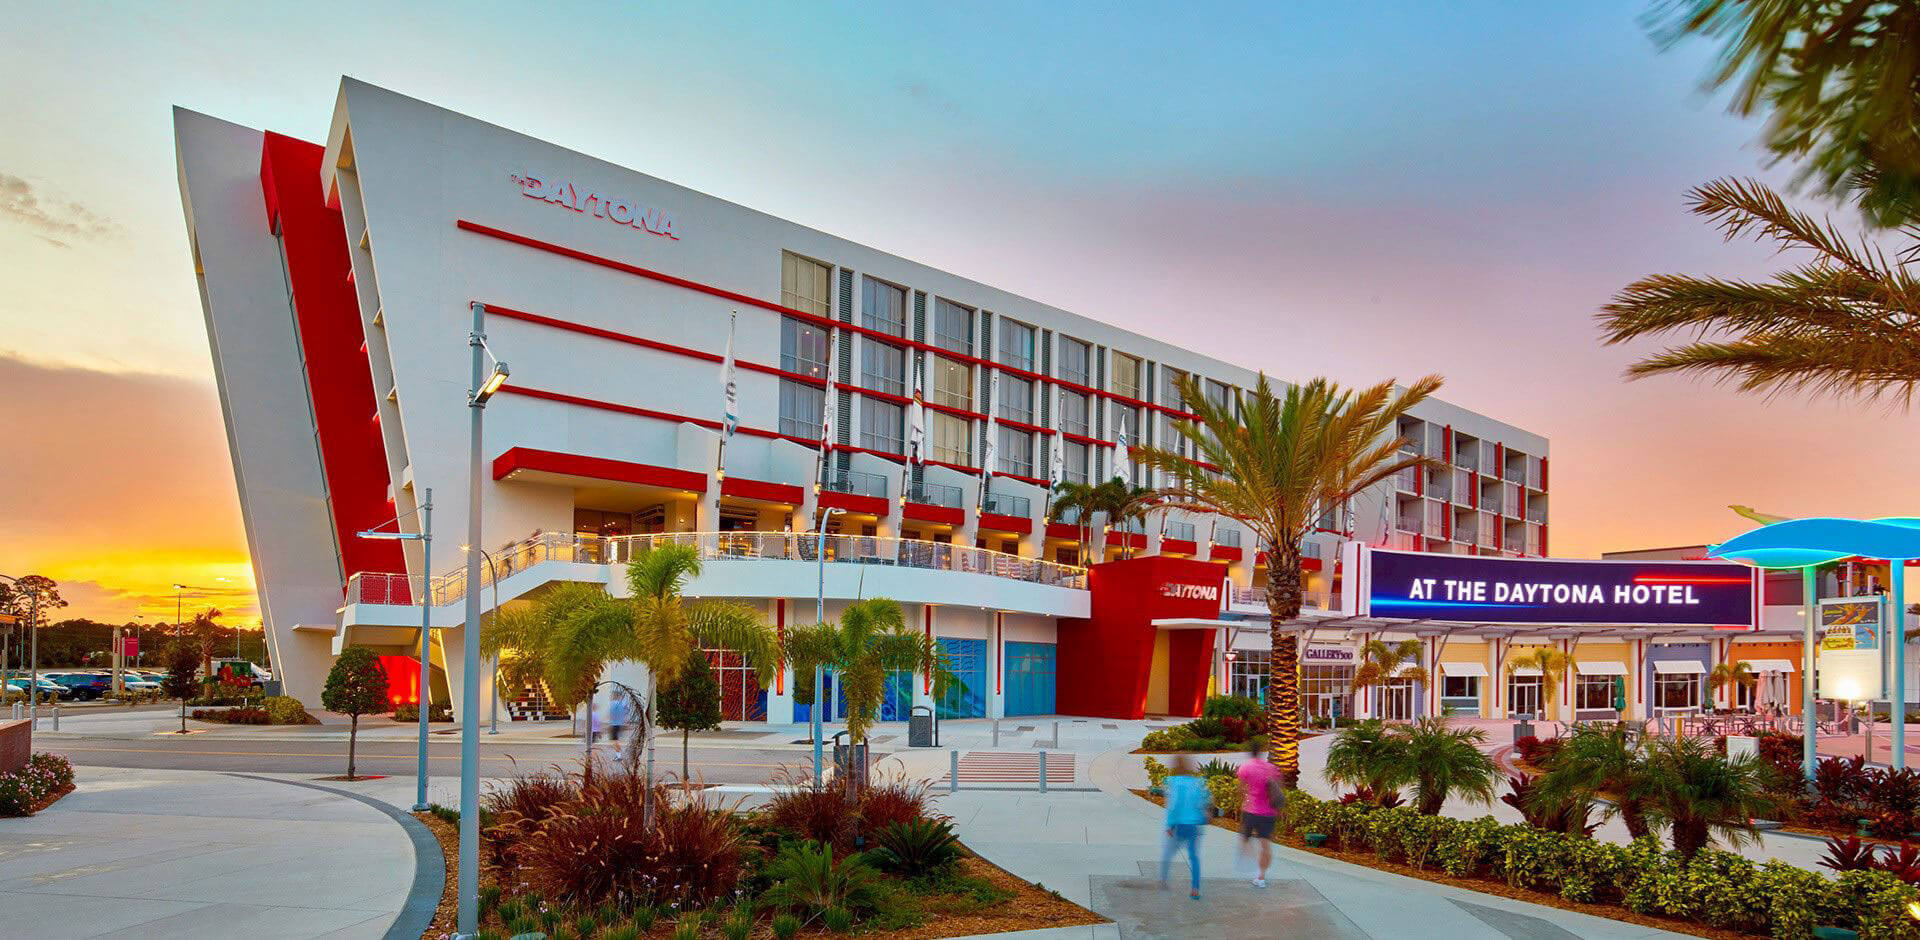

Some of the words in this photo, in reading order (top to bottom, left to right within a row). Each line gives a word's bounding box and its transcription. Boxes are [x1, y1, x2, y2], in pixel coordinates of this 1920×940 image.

[521, 173, 681, 241] DAYTONA
[1409, 578, 1437, 600] AT
[1444, 580, 1487, 602] THE
[1494, 582, 1605, 604] DAYTONA
[1614, 585, 1700, 604] HOTEL
